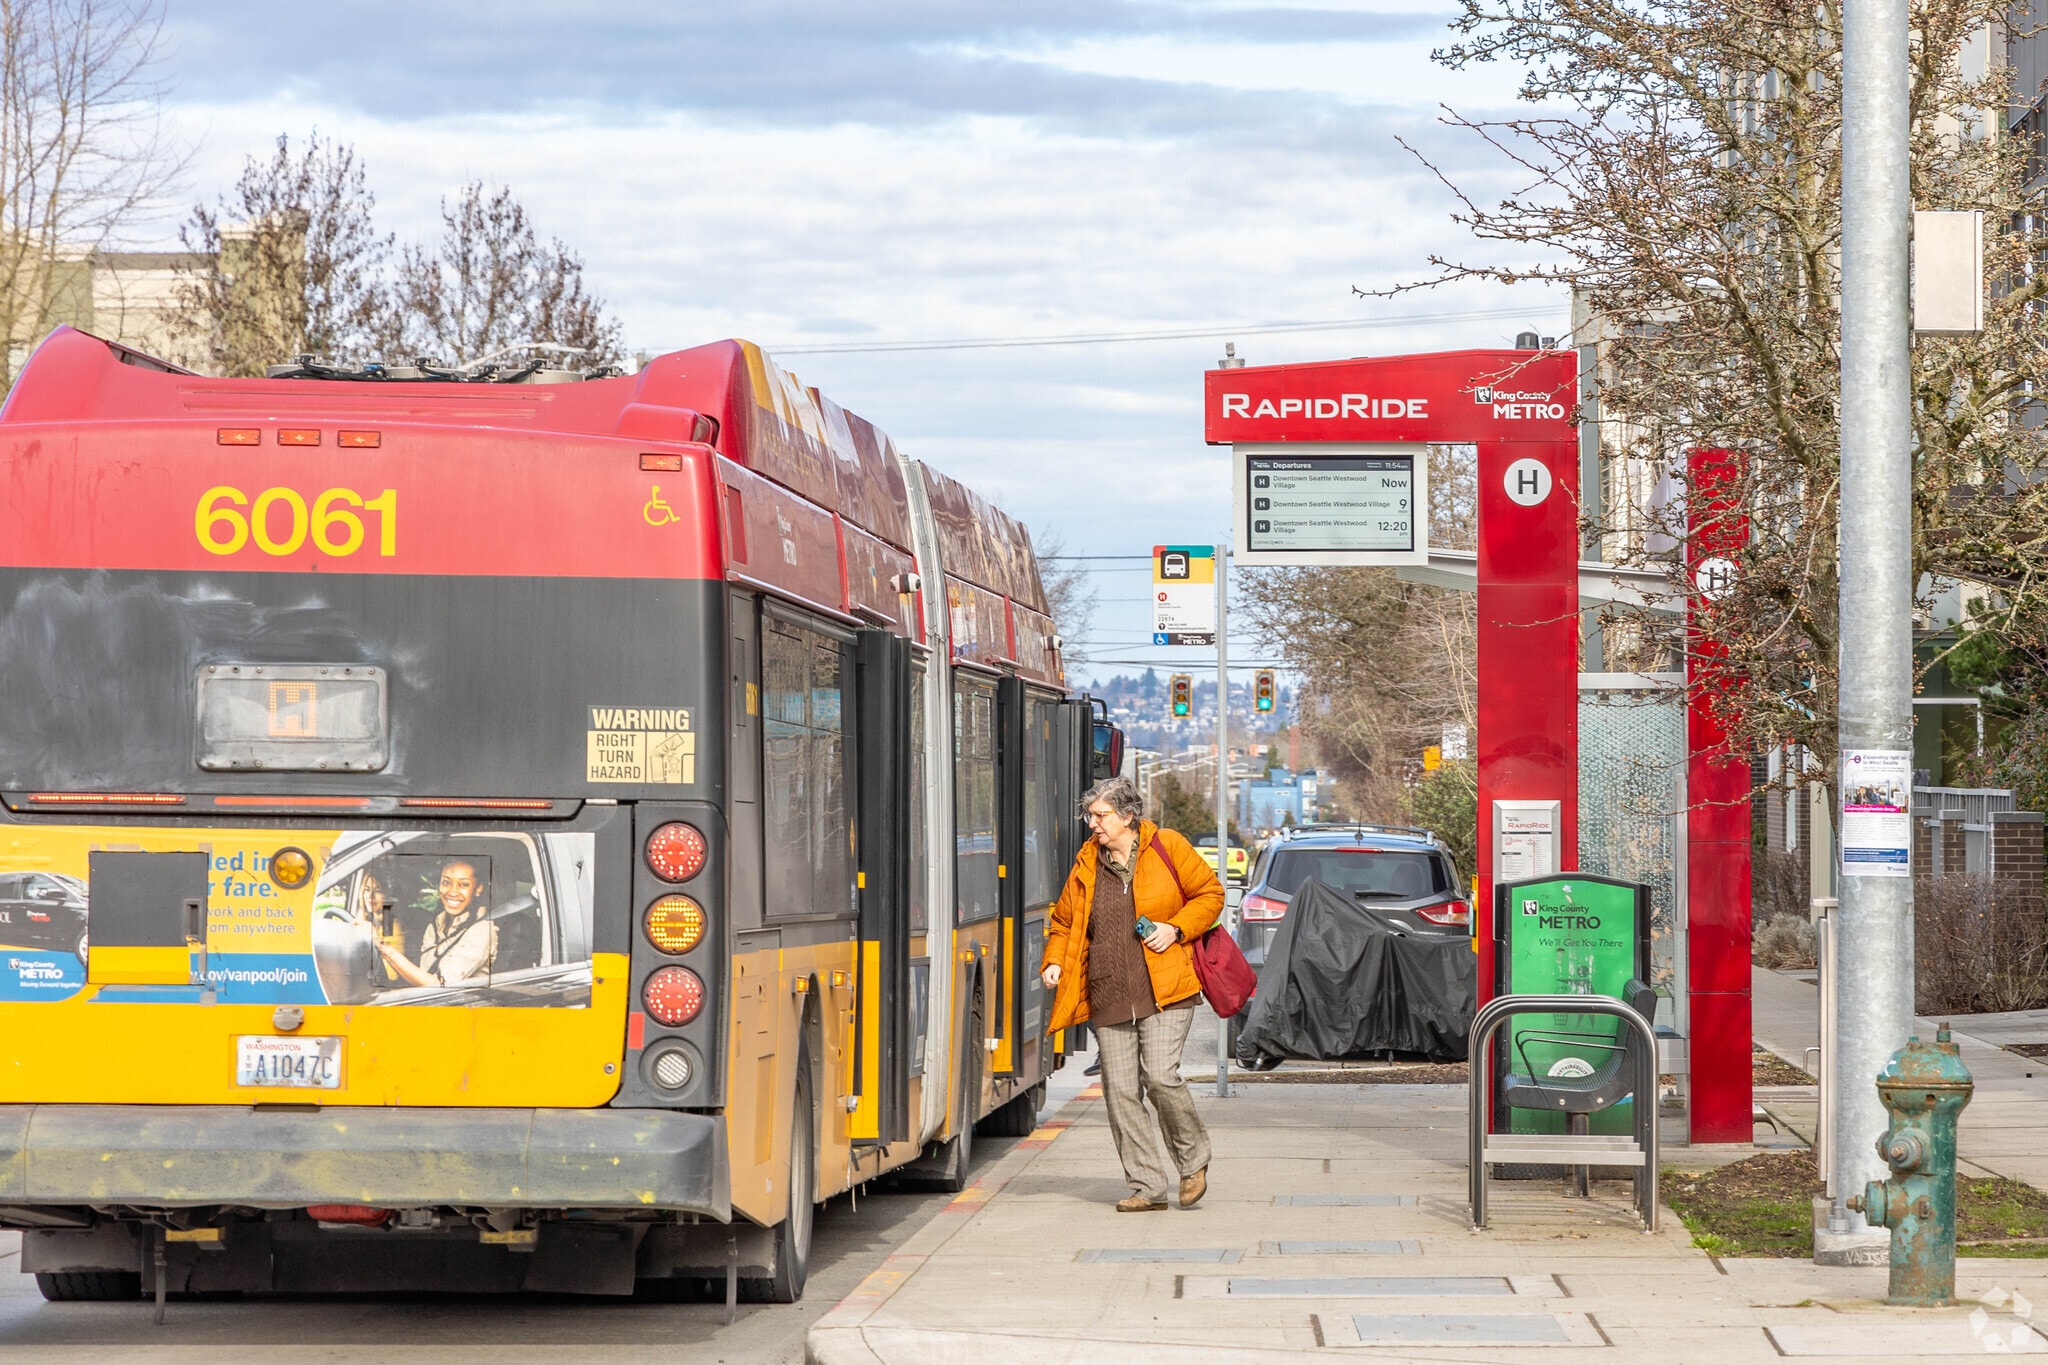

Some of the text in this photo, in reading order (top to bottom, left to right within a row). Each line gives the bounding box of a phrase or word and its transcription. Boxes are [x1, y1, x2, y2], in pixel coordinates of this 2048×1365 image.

[1493, 391, 1515, 403] King
[1493, 404, 1564, 419] METRO
[1273, 462, 1312, 470] Departures
[1259, 478, 1266, 486] H
[1381, 478, 1408, 488] Now
[1518, 470, 1538, 494] H
[1259, 500, 1266, 508] H
[1399, 498, 1407, 510] 9
[195, 486, 397, 557] 6061
[1378, 522, 1408, 531] 12:20
[1710, 567, 1728, 592] H
[592, 708, 690, 731] WARNING
[596, 734, 637, 747] RIGHT
[598, 750, 634, 763] TURN
[591, 766, 641, 779] HAZARD
[223, 876, 278, 897] fare.
[238, 906, 261, 918] and
[266, 906, 294, 918] back
[1539, 905, 1589, 914] King County
[234, 922, 298, 936] anywhere.
[1539, 916, 1601, 930] METRO
[1539, 938, 1624, 948] We'll Get You There
[34, 961, 55, 969] County
[20, 969, 63, 979] METRO
[256, 1054, 333, 1080] A1047C
